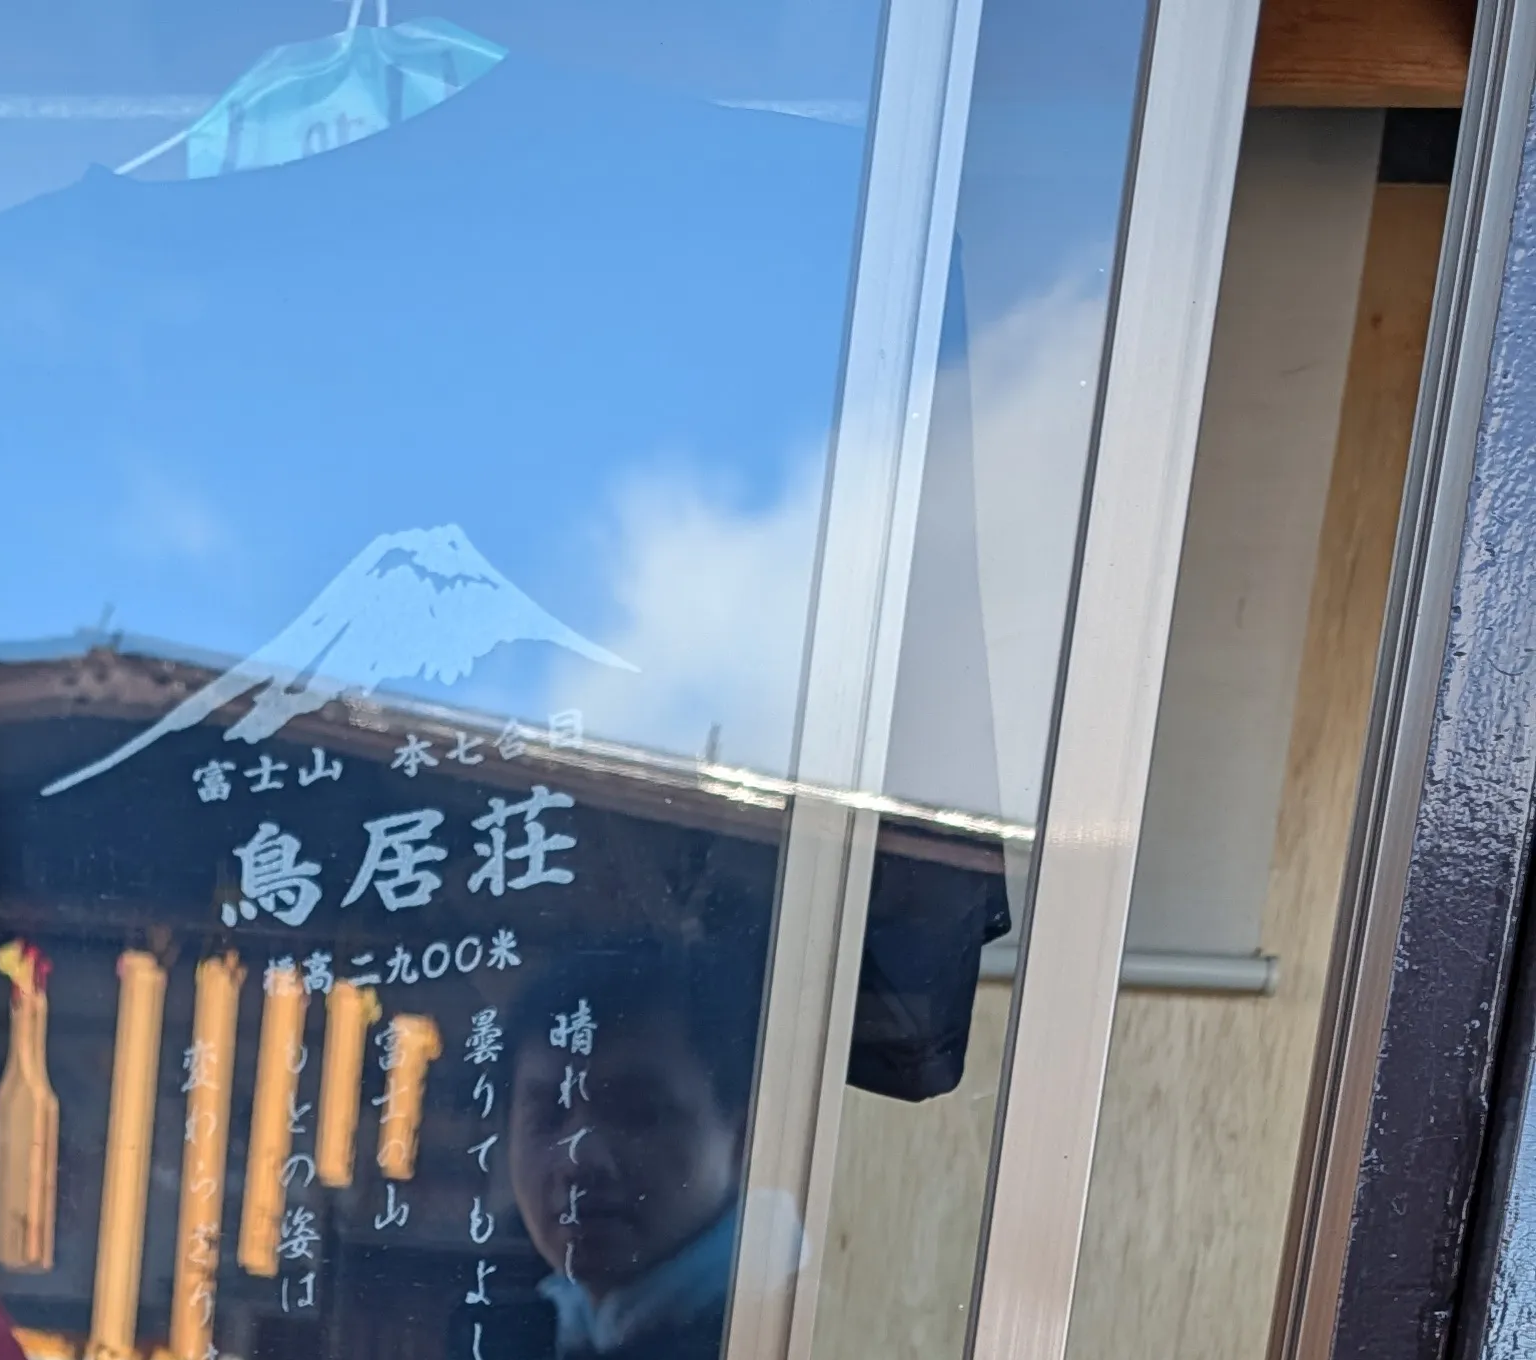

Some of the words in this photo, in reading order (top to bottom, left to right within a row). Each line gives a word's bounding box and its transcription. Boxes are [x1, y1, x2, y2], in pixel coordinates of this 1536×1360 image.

[191, 746, 344, 803] 富士山
[221, 785, 577, 928] 鳥居荘
